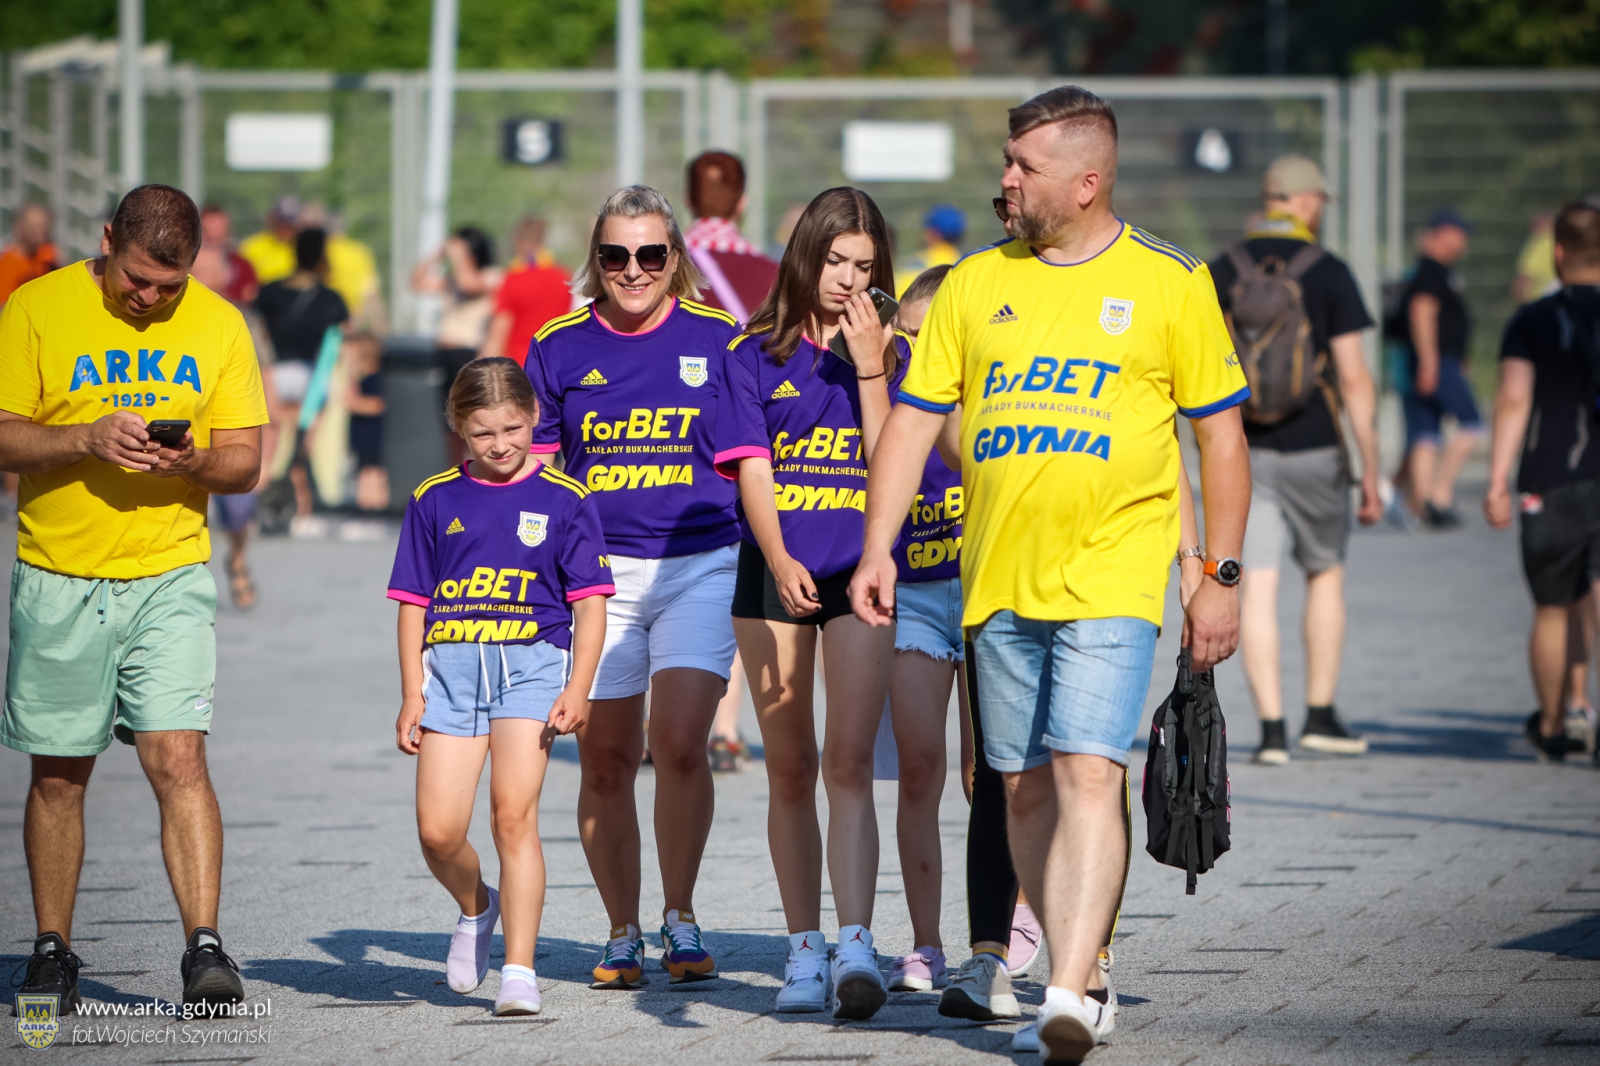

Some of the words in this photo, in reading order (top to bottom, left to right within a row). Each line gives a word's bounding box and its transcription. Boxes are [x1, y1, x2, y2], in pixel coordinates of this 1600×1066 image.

[989, 315, 1018, 325] adidas
[69, 349, 202, 394] ARKA
[1224, 351, 1240, 370] NO
[580, 378, 608, 386] adidas
[982, 355, 1121, 399] forBET
[771, 390, 800, 399] adidas
[1015, 400, 1112, 421] BUKMACHERSKIE
[581, 407, 701, 442] forBET
[585, 445, 624, 454] ZAKŁADY
[625, 444, 694, 453] BUKMACHERSKIE
[973, 424, 1111, 463] GDYNIA
[586, 464, 693, 492] GDYNIA
[909, 485, 965, 526] forB
[906, 536, 963, 570] GDY
[426, 619, 538, 644] GDYNIA
